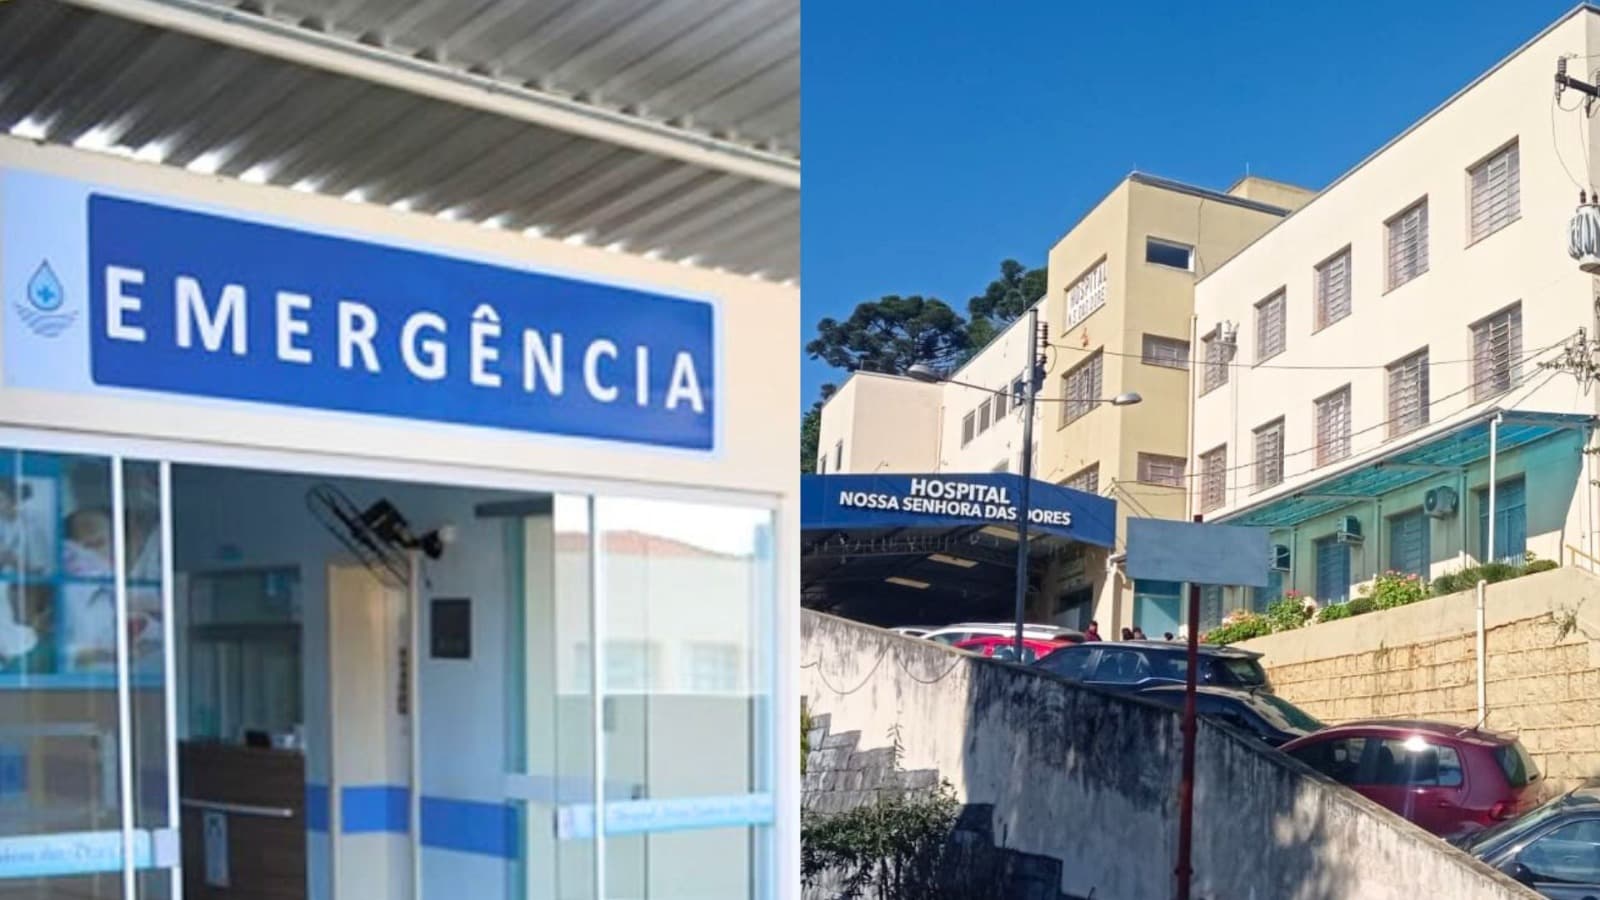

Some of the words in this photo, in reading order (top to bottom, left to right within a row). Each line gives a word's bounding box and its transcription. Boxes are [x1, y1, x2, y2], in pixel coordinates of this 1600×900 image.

[105, 265, 705, 413] EMERGÊNCIA
[839, 491, 900, 510] NOSSA
[902, 497, 982, 518] SENHORA
[984, 504, 1017, 520] DAS
[909, 478, 1011, 504] HOSPITAL
